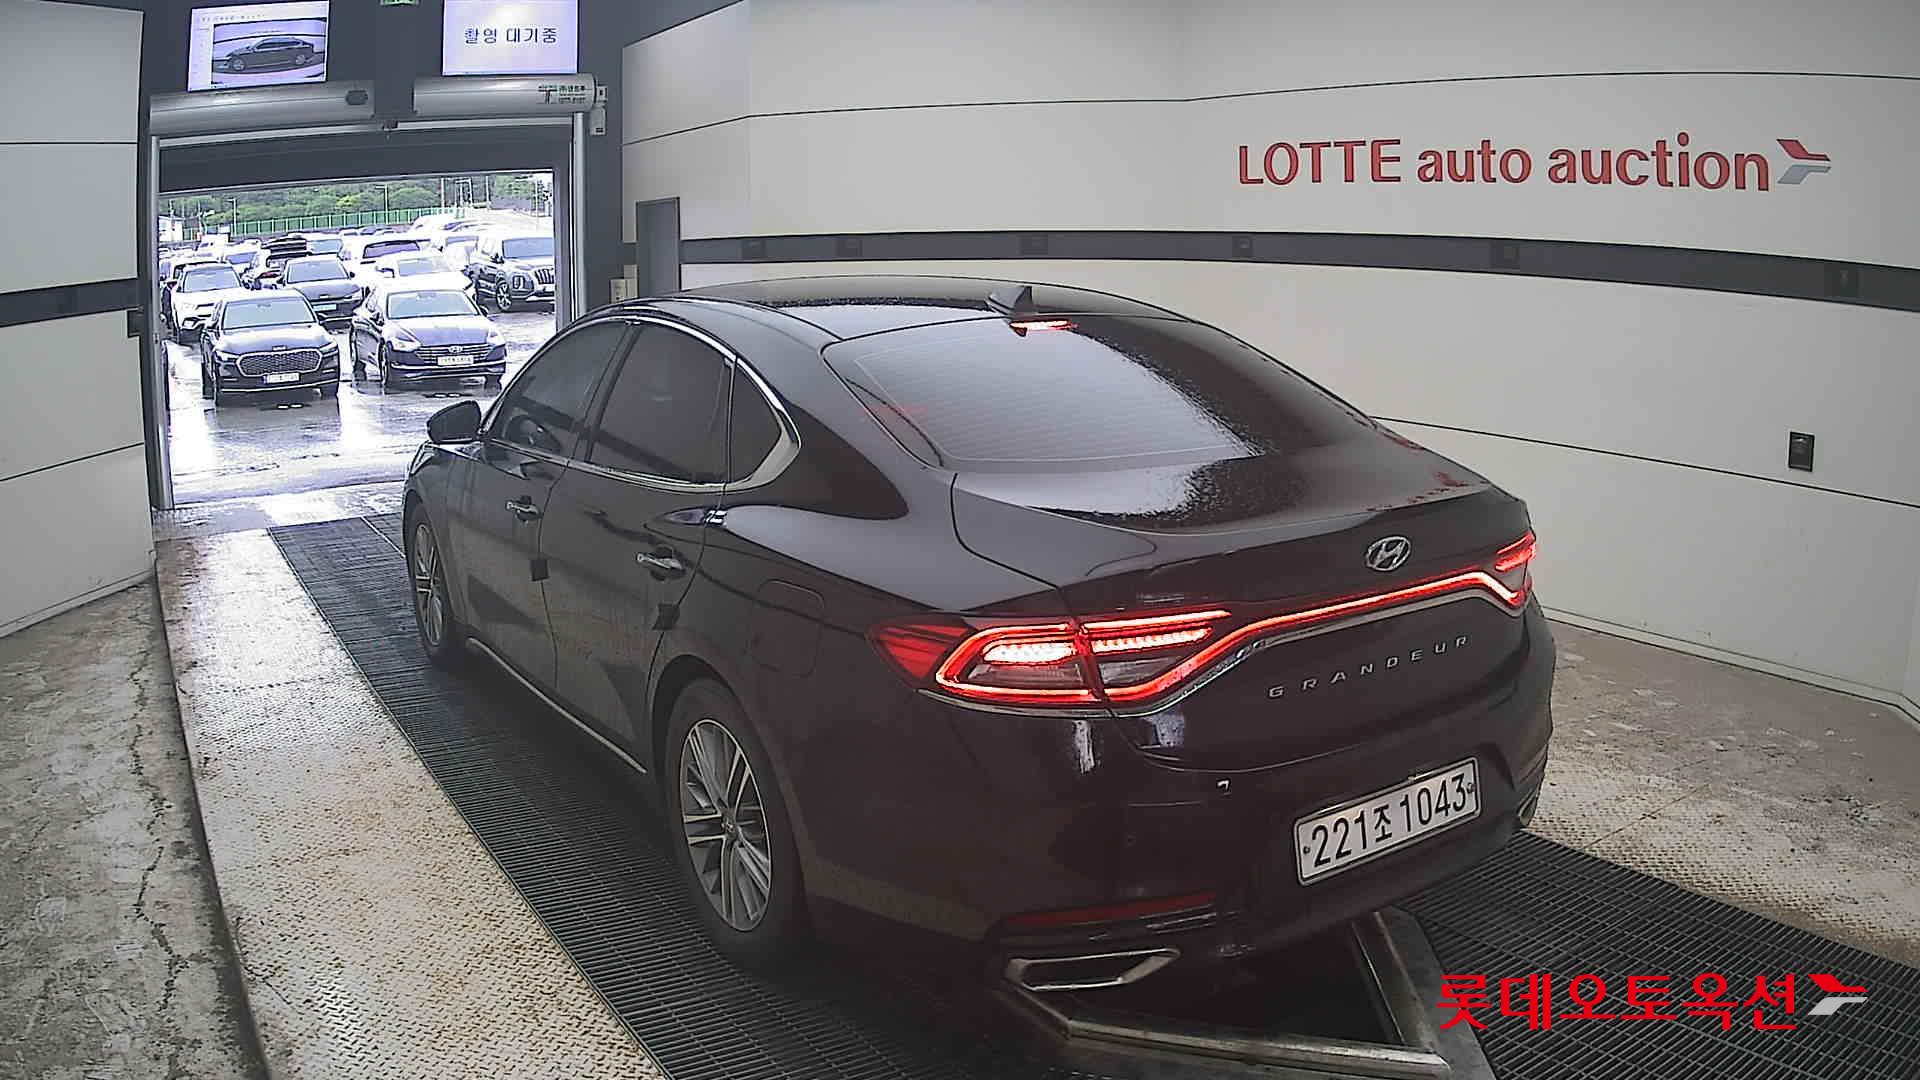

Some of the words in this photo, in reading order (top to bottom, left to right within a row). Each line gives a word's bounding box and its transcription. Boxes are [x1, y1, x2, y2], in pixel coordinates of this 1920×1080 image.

[464, 27, 497, 45] 촬영
[505, 27, 557, 44] 대기중
[1238, 138, 1401, 185] LOTTE
[1416, 139, 1533, 184] auto
[1547, 131, 1770, 192] auction
[1267, 634, 1468, 698] GRANDEUR
